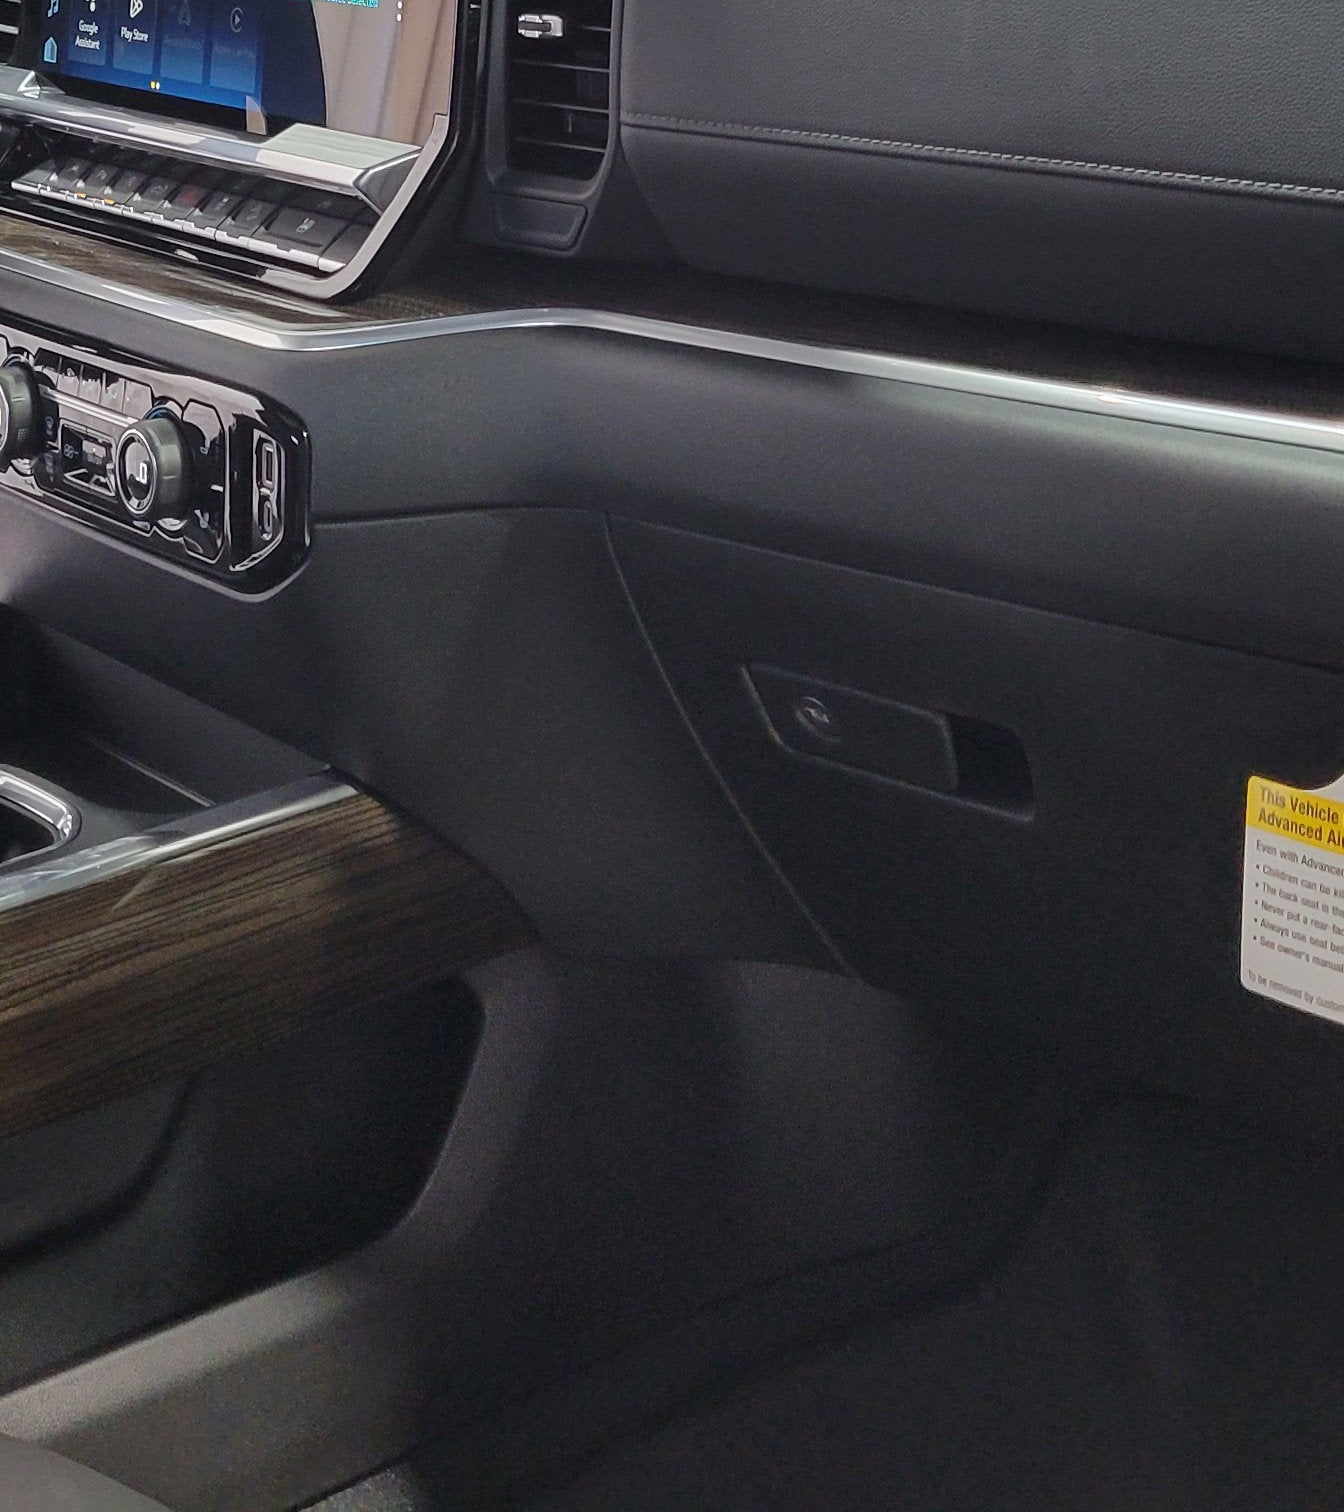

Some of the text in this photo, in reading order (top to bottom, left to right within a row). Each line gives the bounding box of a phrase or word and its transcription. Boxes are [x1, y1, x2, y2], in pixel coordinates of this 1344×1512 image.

[75, 35, 100, 50] Assistant
[78, 19, 99, 36] Google
[120, 26, 149, 42] Play Store
[1260, 786, 1286, 808] This
[1290, 797, 1339, 825] Vehicle
[1258, 807, 1322, 842] Advanced
[1256, 839, 1277, 856] Even
[1280, 849, 1299, 864] with
[1263, 864, 1298, 884] Children
[1300, 878, 1317, 890] can
[1319, 883, 1330, 895] be
[1261, 899, 1284, 916] Never
[1287, 911, 1300, 923] put
[1303, 916, 1308, 924] a
[1263, 882, 1276, 895] The
[1279, 889, 1298, 902] back
[1301, 896, 1319, 910] seat
[1322, 903, 1329, 913] is
[1260, 918, 1289, 937] Always
[1291, 931, 1307, 942] use
[1309, 936, 1327, 949] seat
[1259, 935, 1275, 950] See
[1277, 944, 1309, 962] owner's
[1312, 956, 1344, 973] manual
[1248, 969, 1257, 982] To
[1258, 974, 1267, 985] be
[1269, 978, 1303, 999] removed
[1304, 991, 1314, 1004] by
